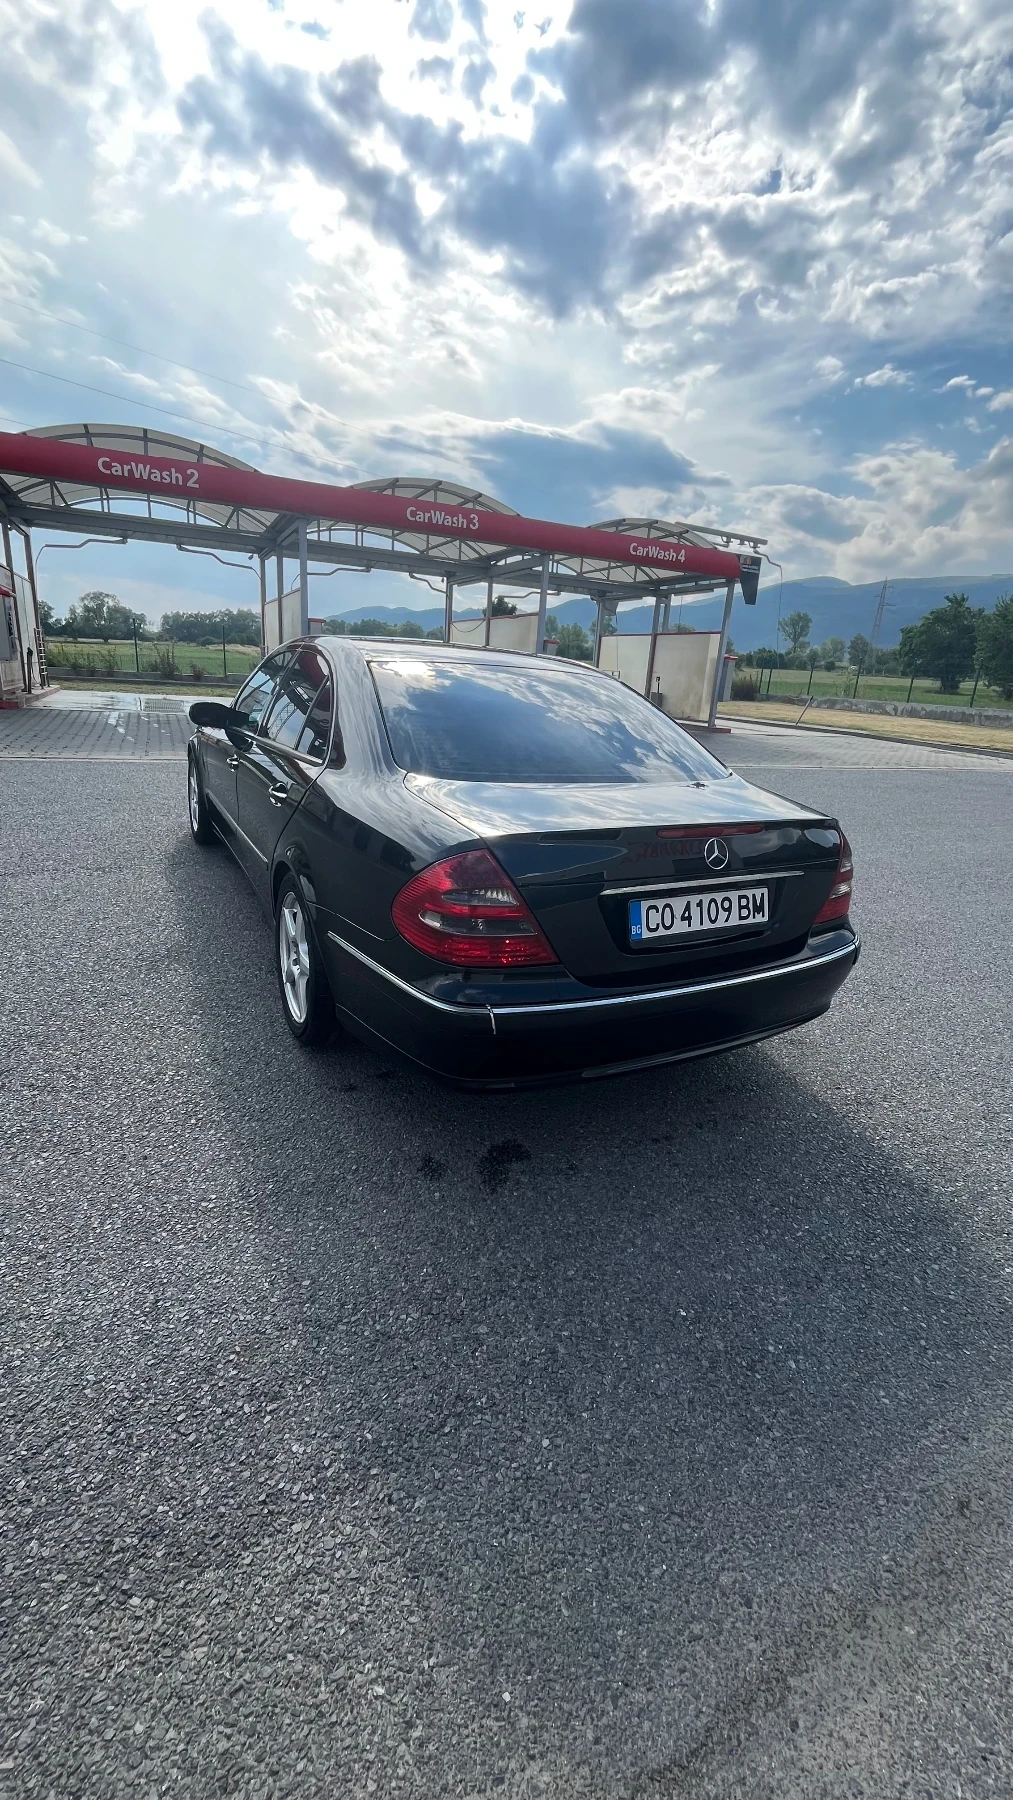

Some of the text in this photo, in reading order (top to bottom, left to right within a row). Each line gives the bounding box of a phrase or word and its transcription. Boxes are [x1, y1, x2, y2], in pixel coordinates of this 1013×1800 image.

[97, 457, 200, 488] CarWash 2
[406, 506, 479, 530] CarWash 3
[629, 543, 686, 562] CarWash 4
[645, 892, 765, 933] CO 4109 BM
[631, 925, 642, 935] BG
